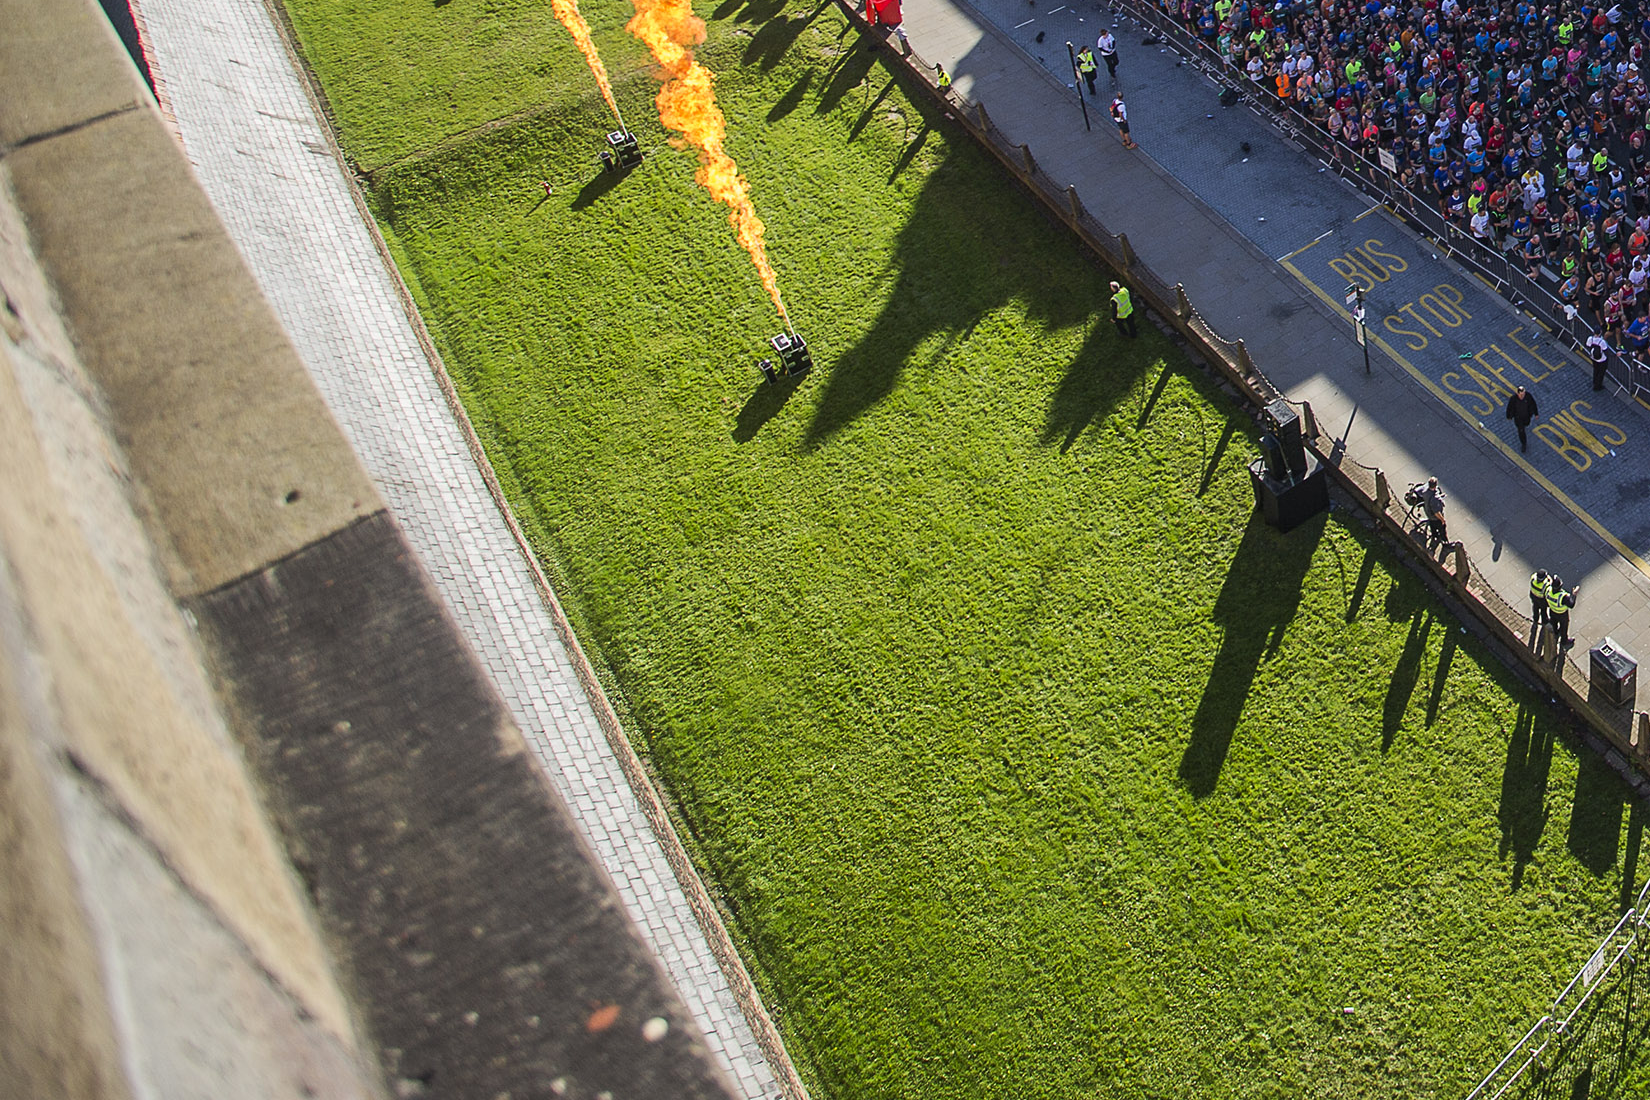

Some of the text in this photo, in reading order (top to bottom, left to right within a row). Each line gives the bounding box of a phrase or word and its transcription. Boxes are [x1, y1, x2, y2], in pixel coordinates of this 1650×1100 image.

[1328, 238, 1408, 291] BUS
[1383, 283, 1473, 352] STOP
[1440, 326, 1567, 415] SAFLE
[1532, 400, 1627, 473] BWS
